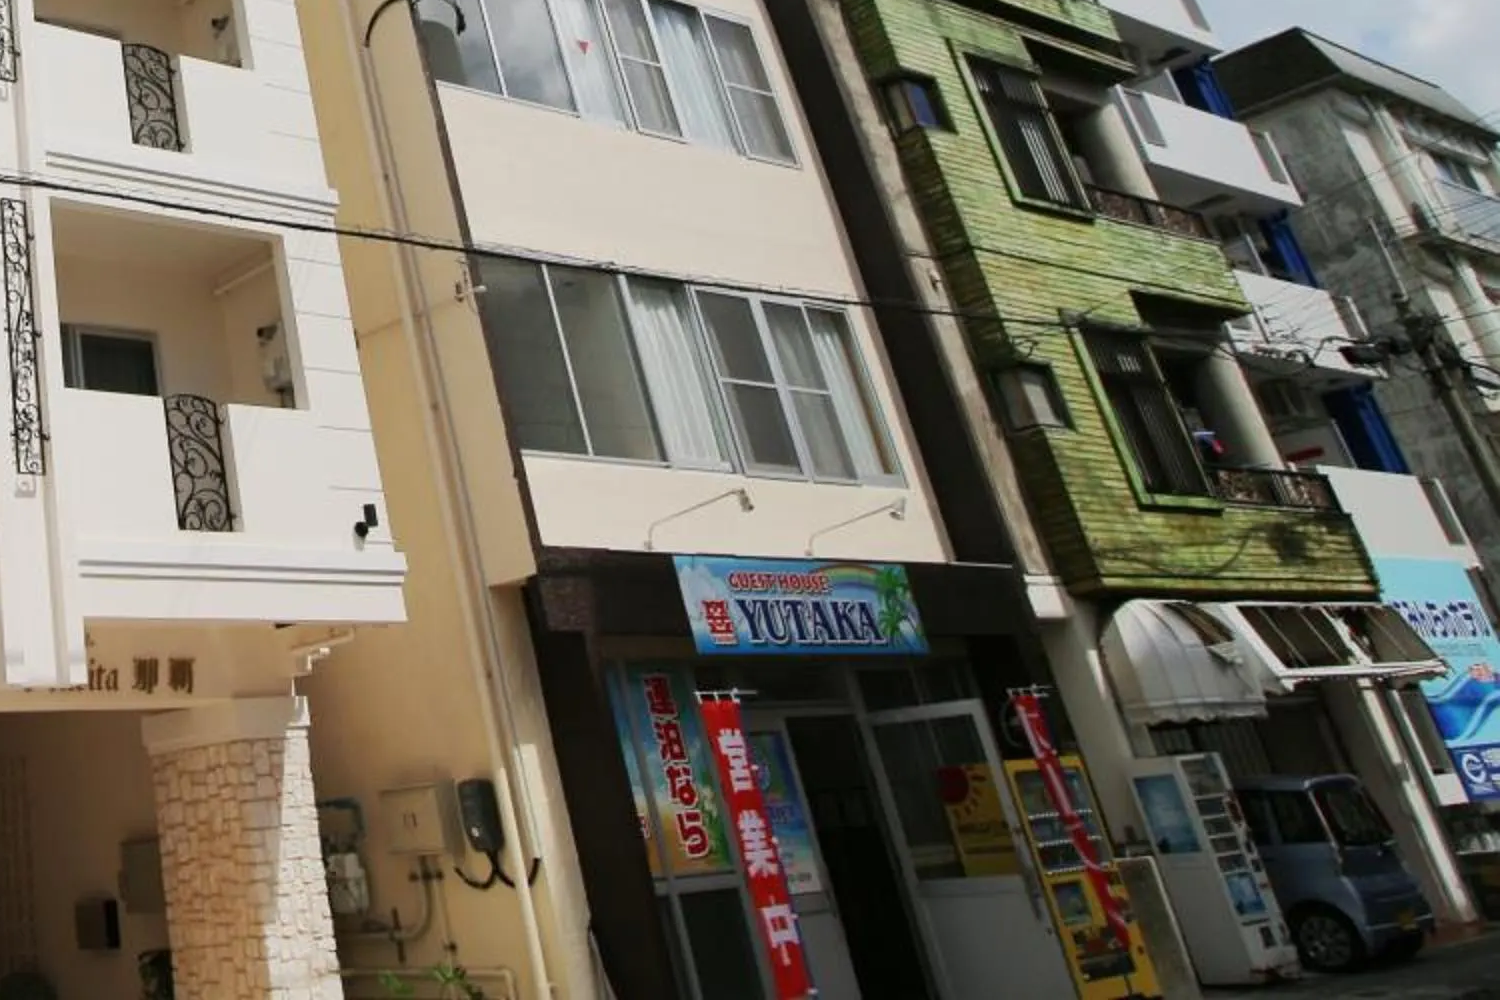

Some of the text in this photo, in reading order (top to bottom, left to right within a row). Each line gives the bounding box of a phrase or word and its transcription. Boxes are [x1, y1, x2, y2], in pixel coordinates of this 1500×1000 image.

[728, 571, 829, 592] GUEST HOUSE
[736, 600, 886, 643] YUTAKA
[717, 727, 800, 966] 営業中
